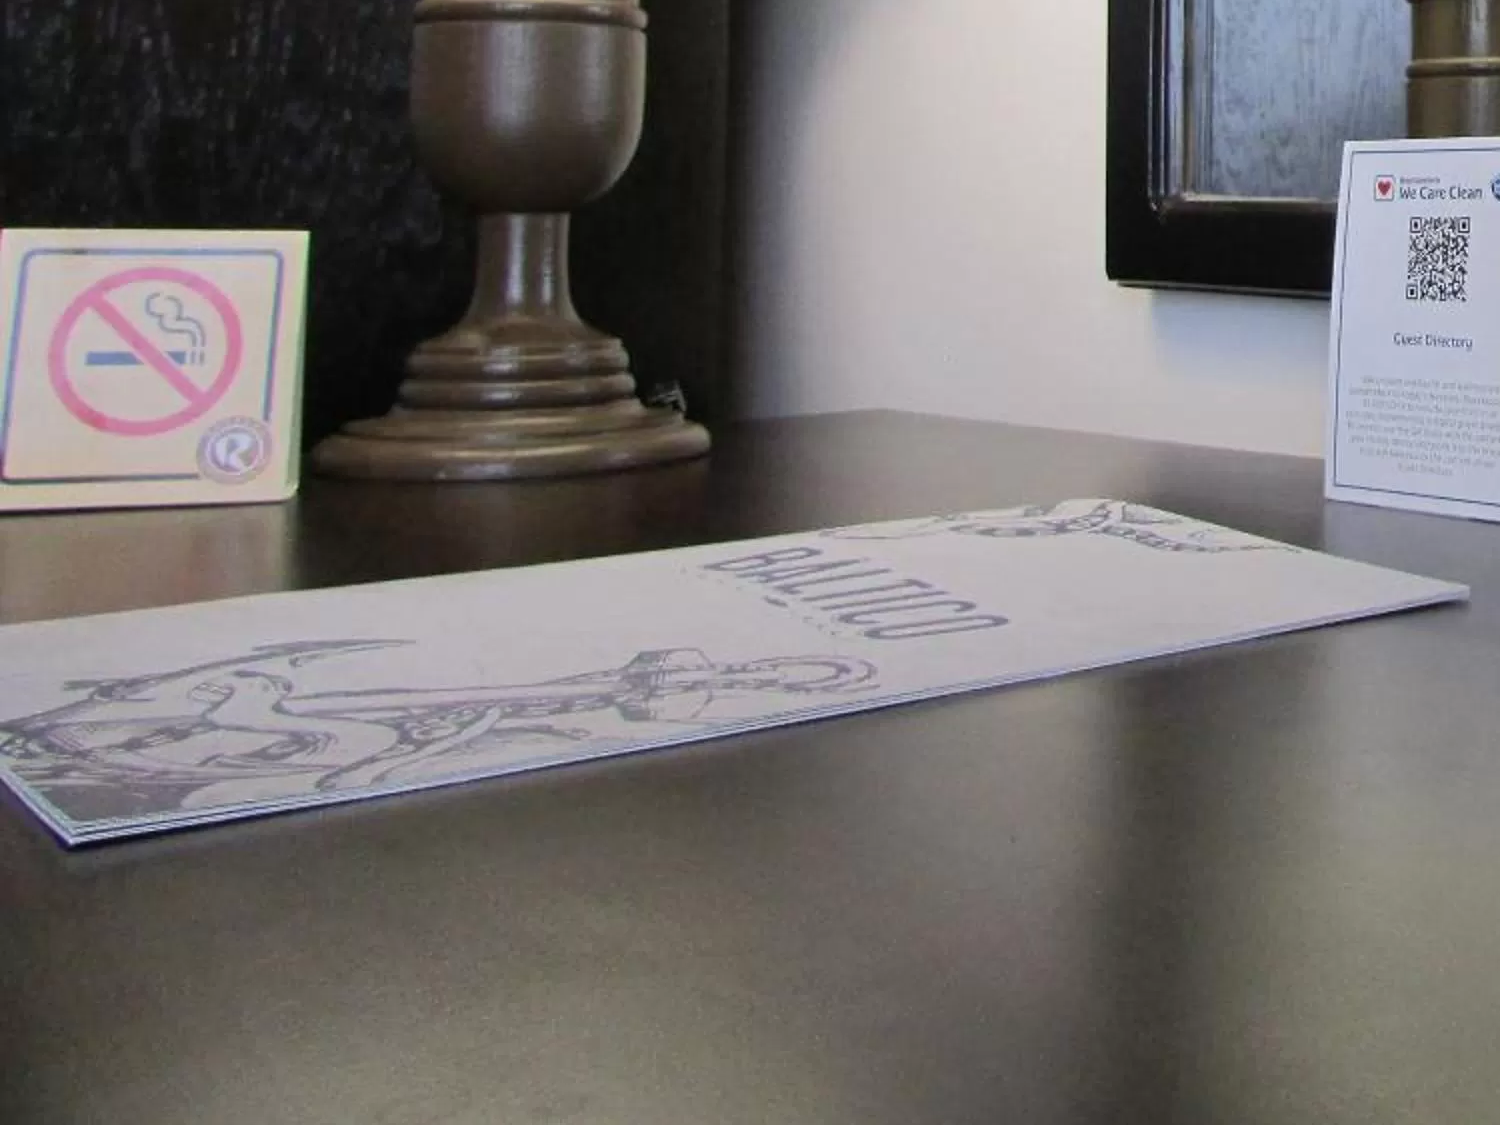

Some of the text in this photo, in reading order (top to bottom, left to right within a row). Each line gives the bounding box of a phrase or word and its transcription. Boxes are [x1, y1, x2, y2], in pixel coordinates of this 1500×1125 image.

[1399, 186, 1417, 200] We
[1419, 186, 1447, 200] Care
[1449, 185, 1483, 201] Clean
[1393, 332, 1473, 351] Guest Directory
